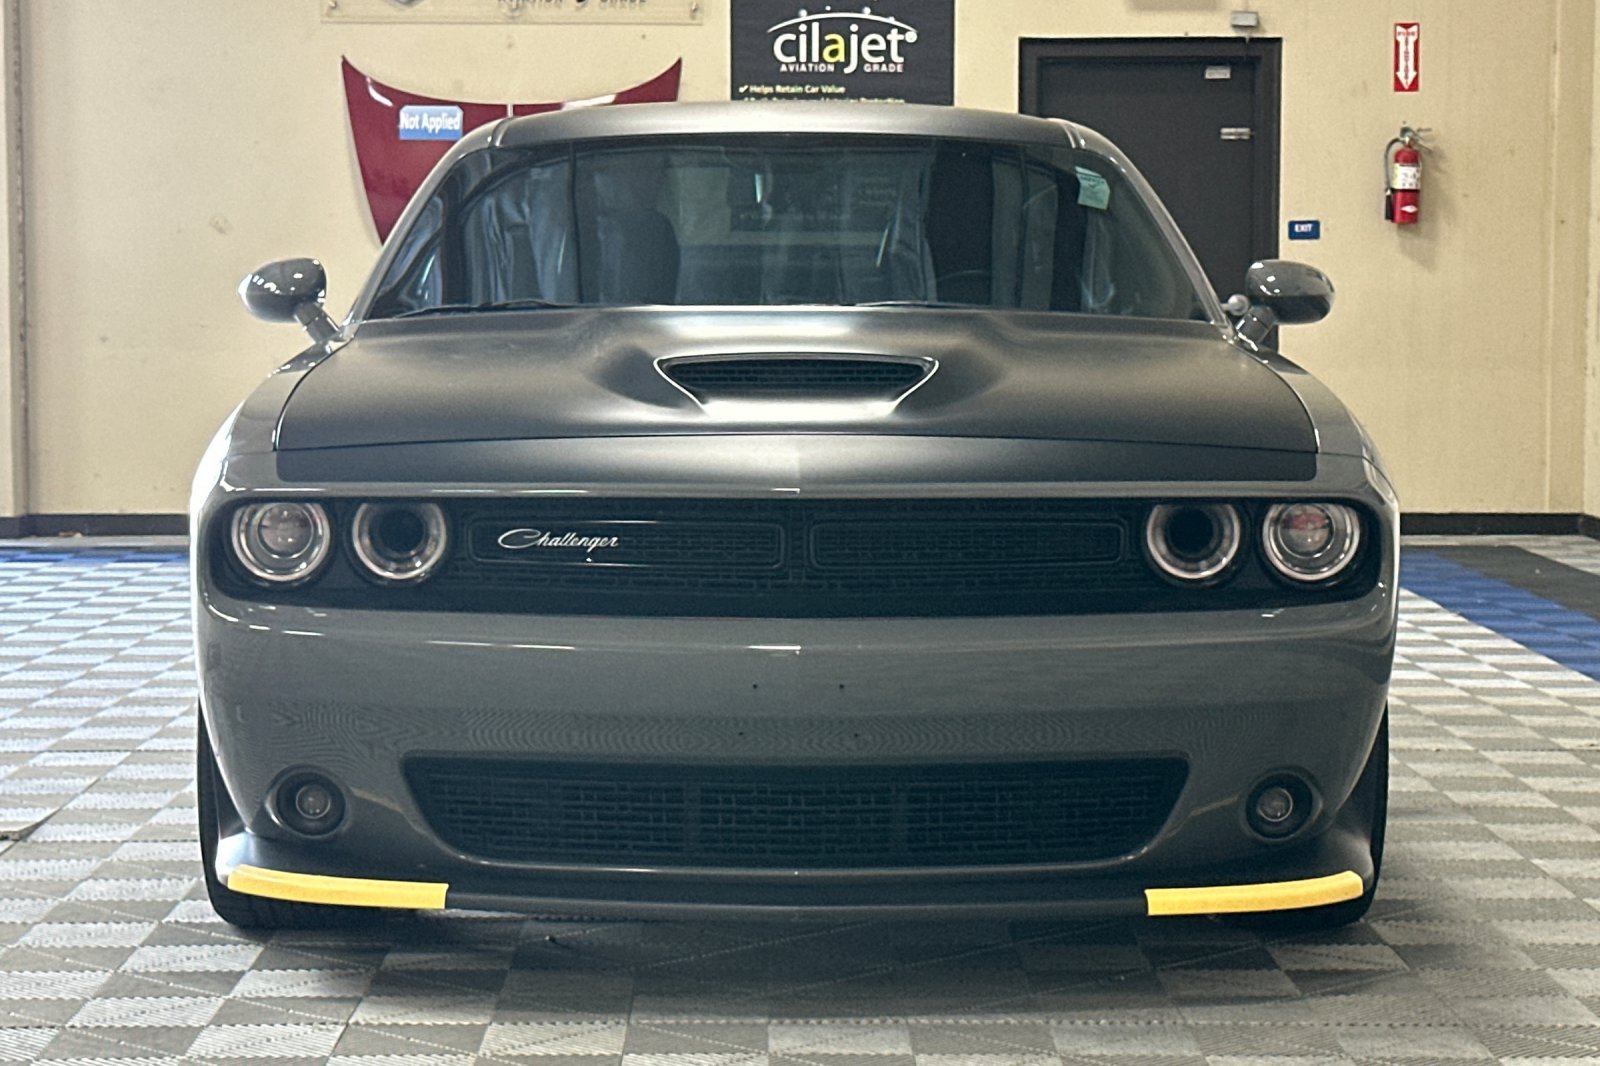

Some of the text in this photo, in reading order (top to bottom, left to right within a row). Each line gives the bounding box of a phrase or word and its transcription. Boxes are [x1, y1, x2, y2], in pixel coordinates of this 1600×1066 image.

[773, 21, 905, 74] cilajet
[779, 63, 904, 73] AVIATION GRADE
[749, 85, 846, 94] Helps Retain Car Value
[399, 112, 460, 134] Not Applied
[498, 528, 619, 553] Challenger
